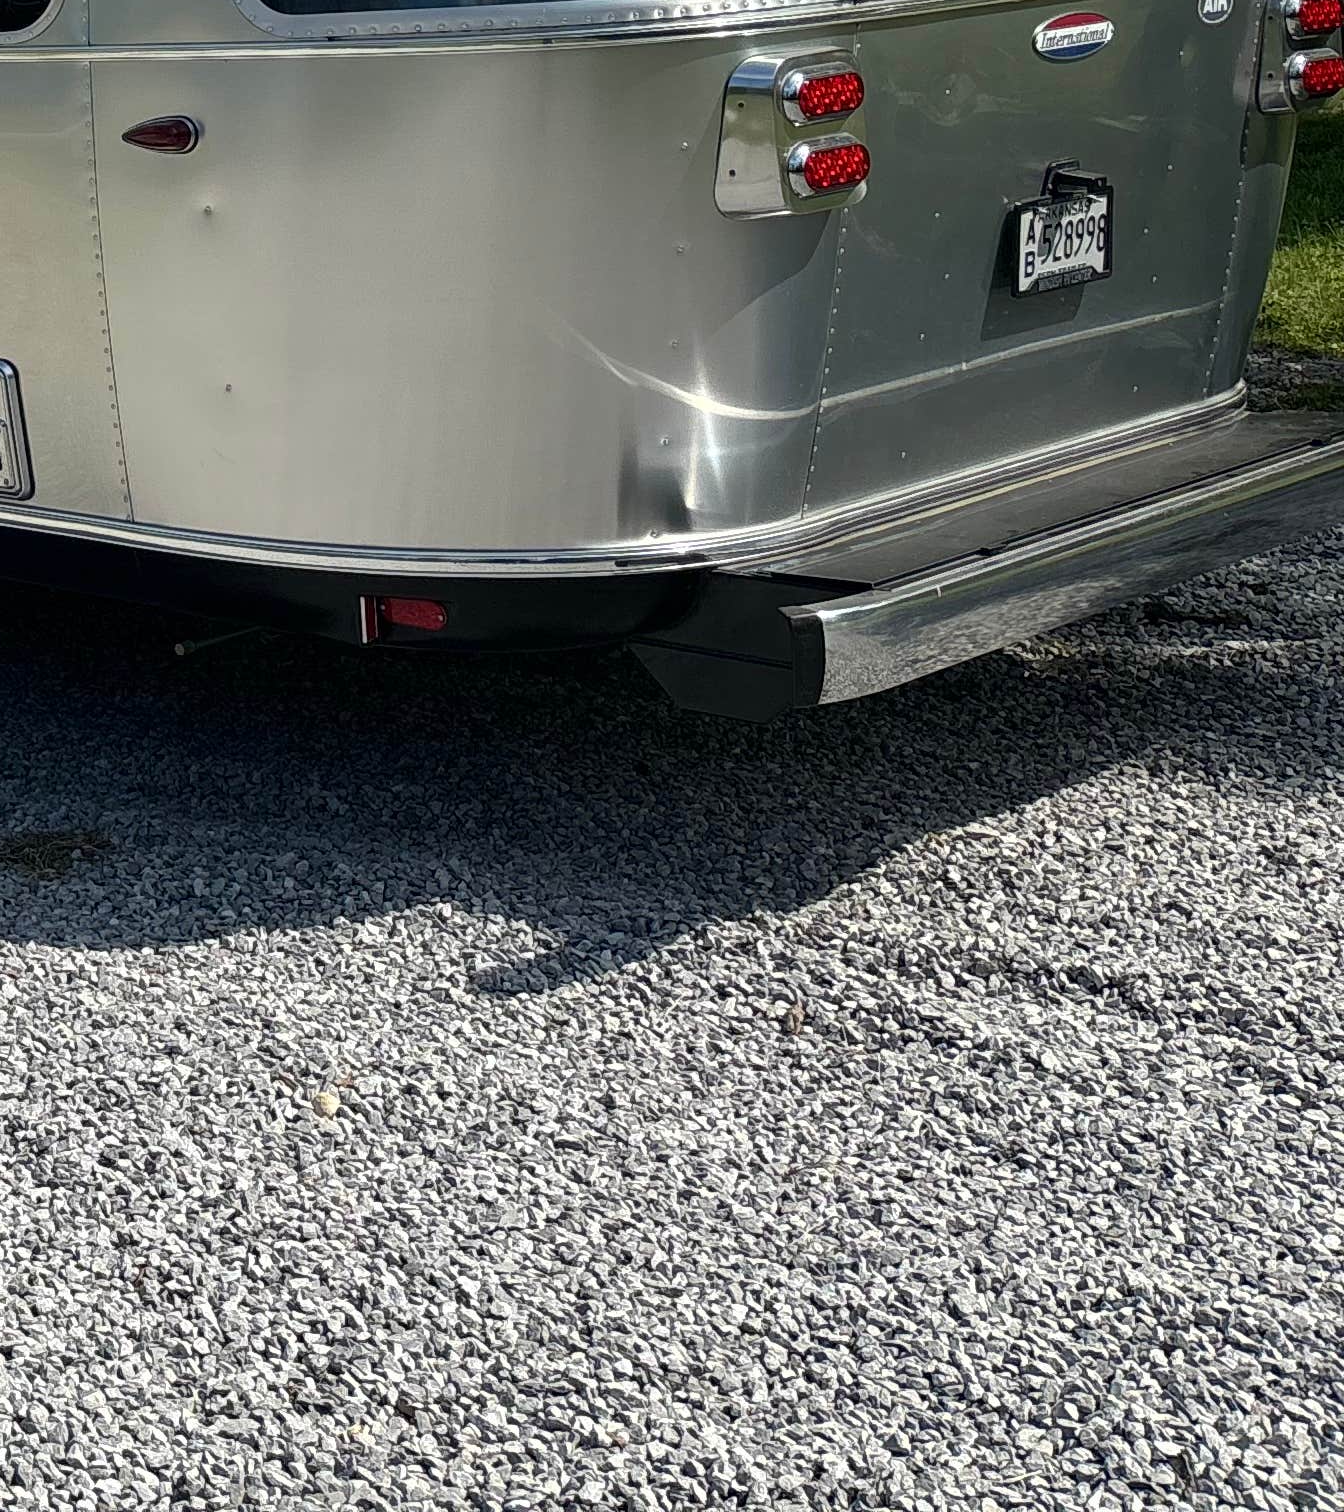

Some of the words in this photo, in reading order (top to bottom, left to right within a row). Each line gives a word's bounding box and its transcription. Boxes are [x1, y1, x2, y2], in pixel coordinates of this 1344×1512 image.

[1040, 22, 1109, 49] International
[1025, 219, 1036, 246] A
[1040, 213, 1107, 265] 528998
[1024, 251, 1036, 278] B
